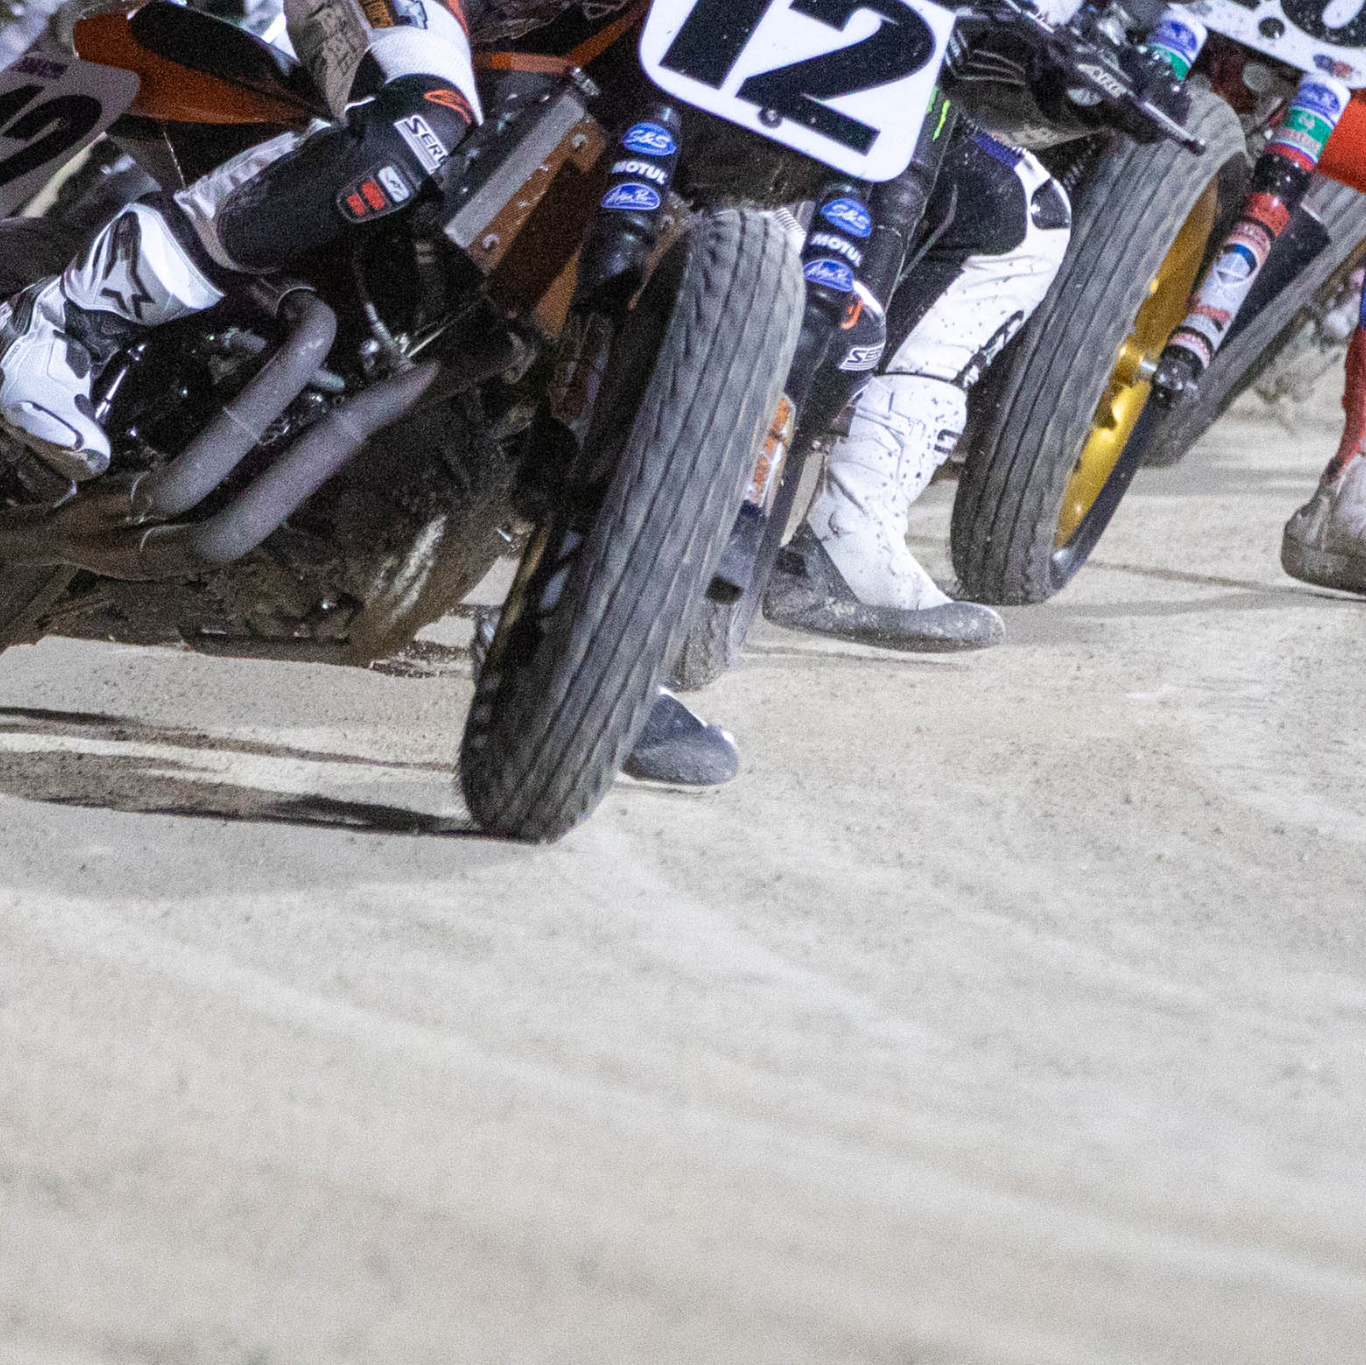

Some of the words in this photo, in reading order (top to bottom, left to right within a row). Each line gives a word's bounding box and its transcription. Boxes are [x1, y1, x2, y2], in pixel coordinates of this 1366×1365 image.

[403, 116, 447, 163] SER
[611, 160, 669, 186] MOTUL
[827, 202, 871, 231] S&S
